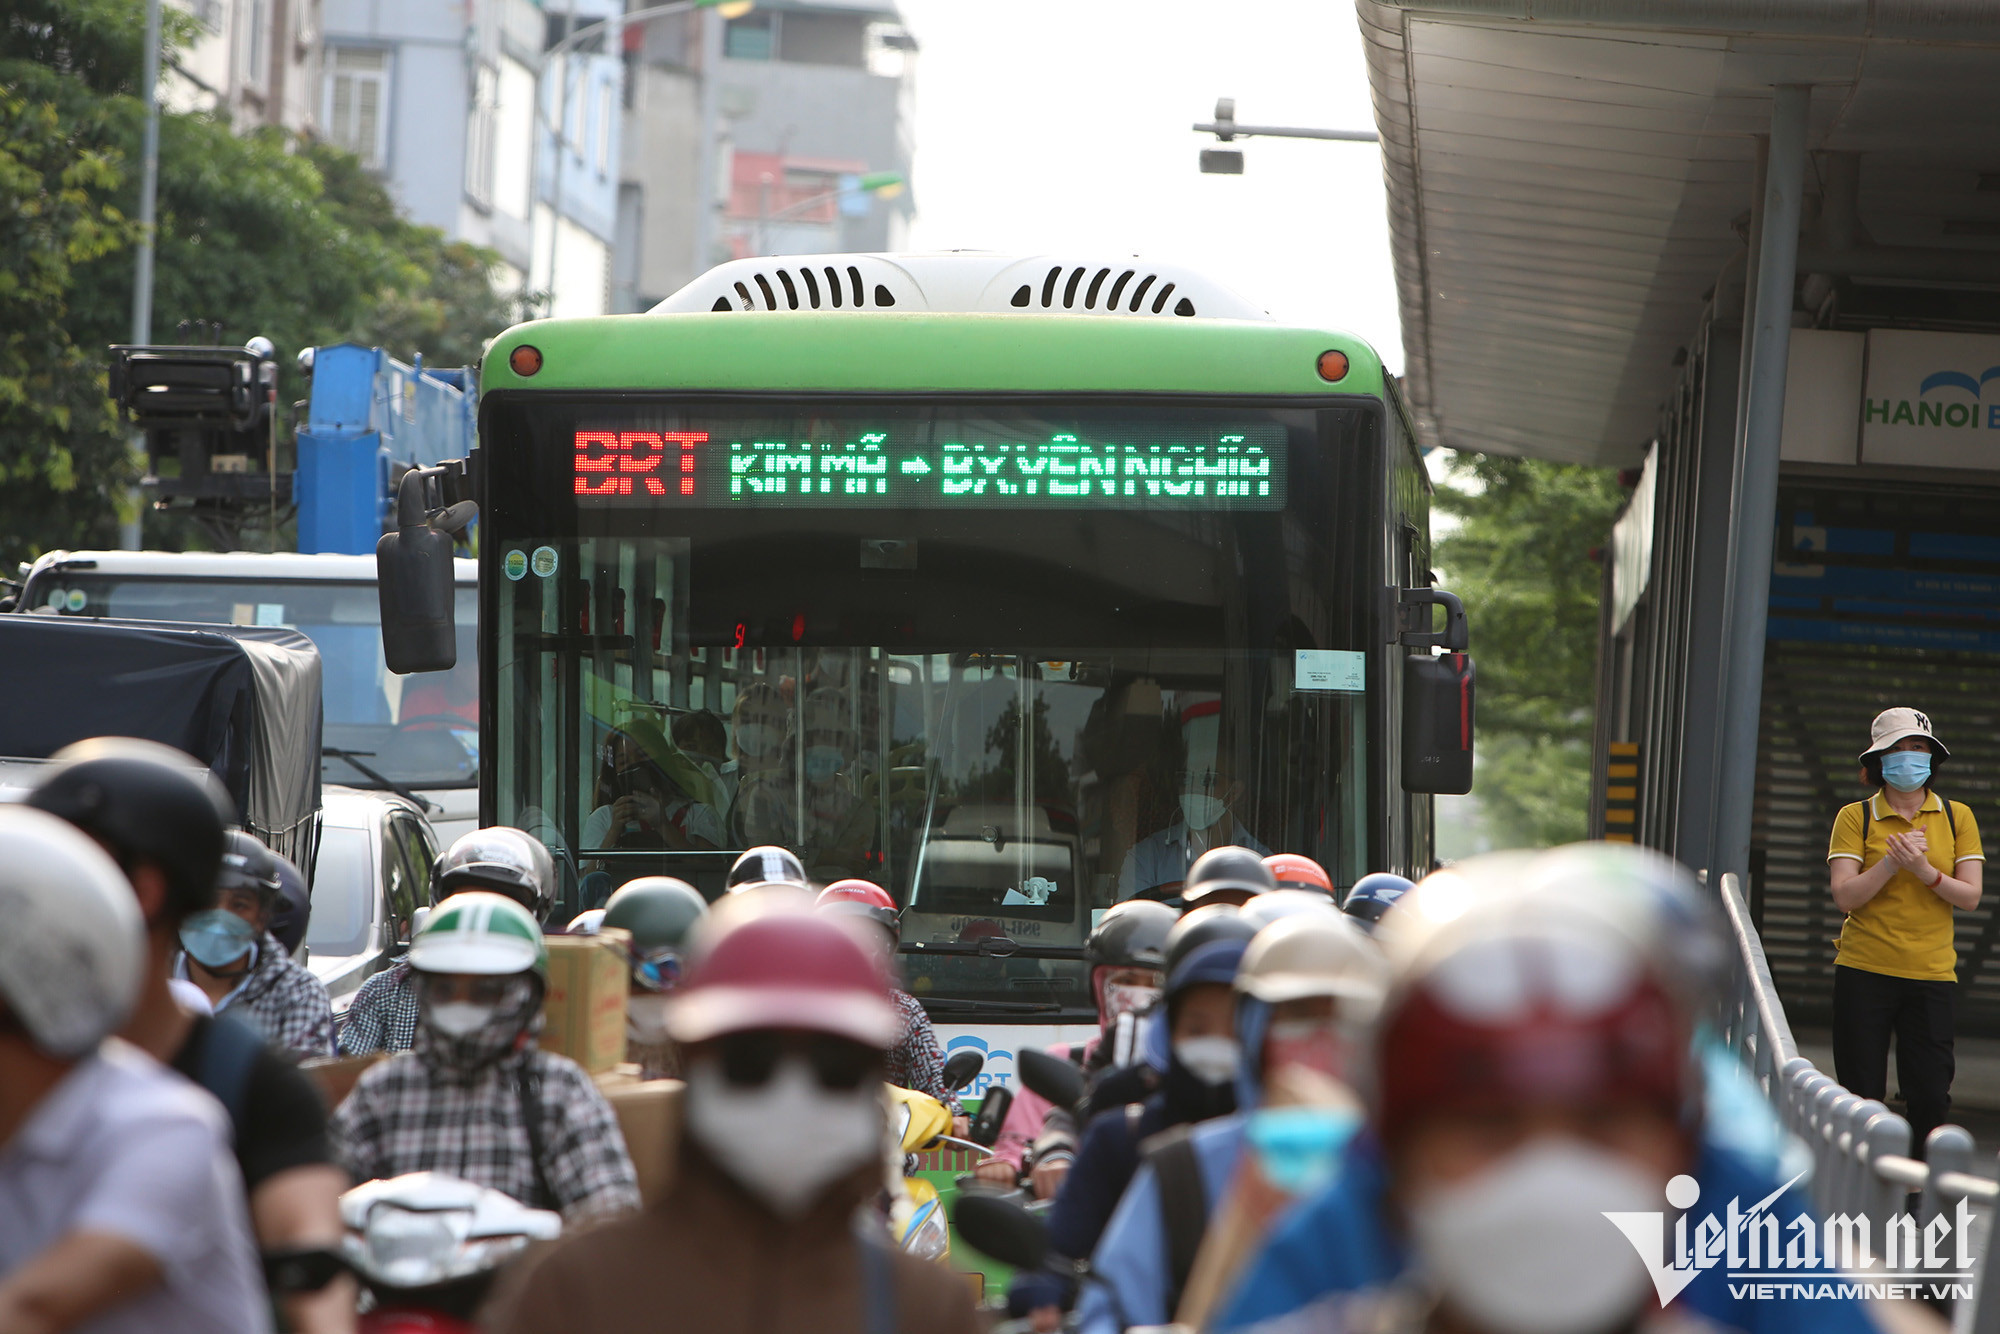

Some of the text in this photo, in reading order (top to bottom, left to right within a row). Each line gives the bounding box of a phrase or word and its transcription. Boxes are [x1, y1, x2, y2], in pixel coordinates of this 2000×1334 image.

[1865, 398, 1980, 429] HANOI
[574, 431, 709, 495] BRT
[730, 442, 812, 494] KIM
[1124, 434, 1271, 496] NGHĨA
[1913, 713, 1930, 733] NY
